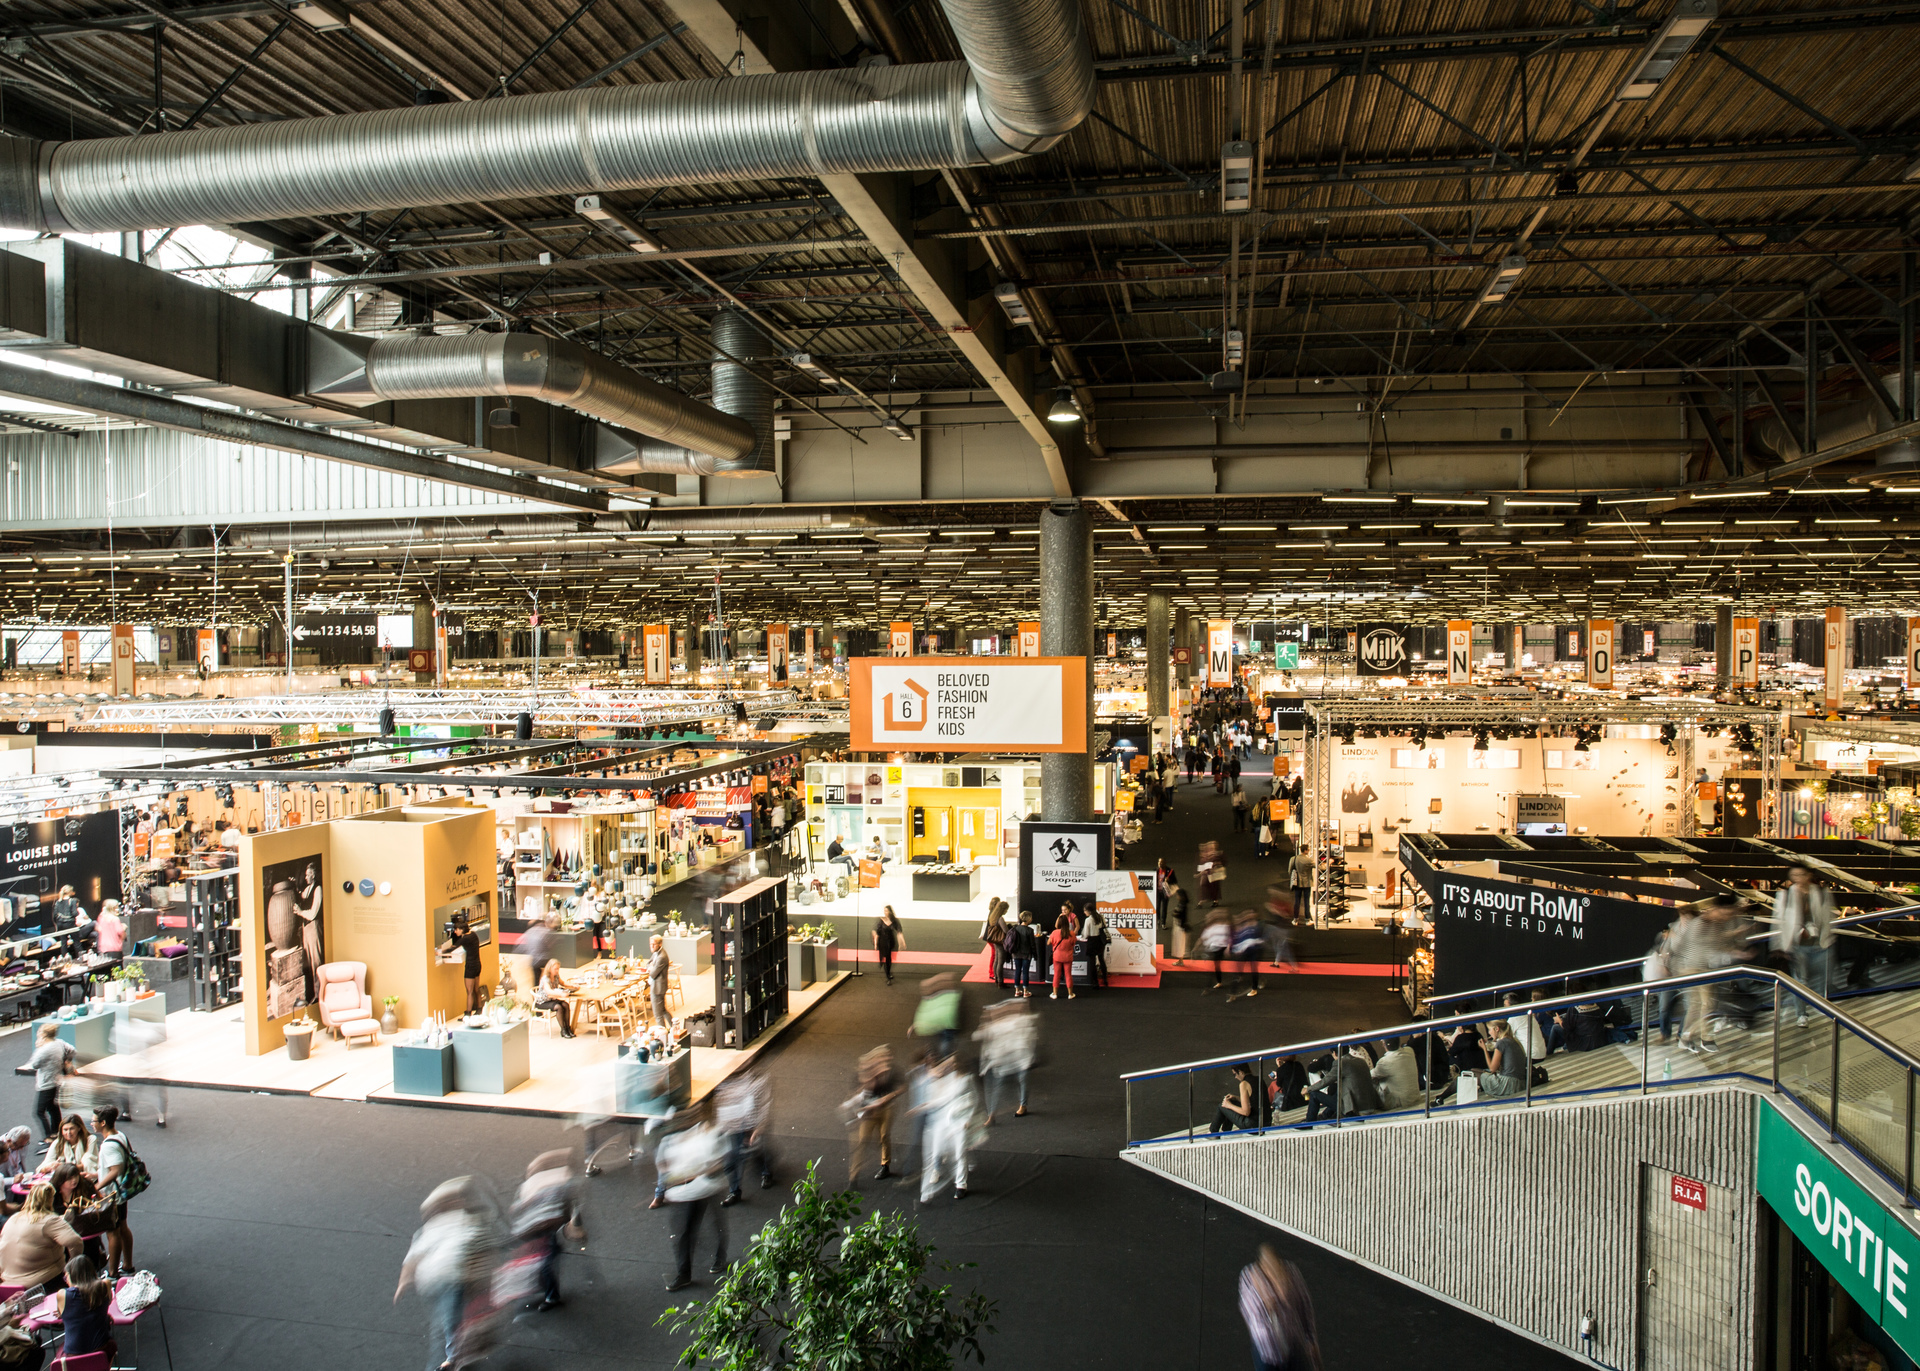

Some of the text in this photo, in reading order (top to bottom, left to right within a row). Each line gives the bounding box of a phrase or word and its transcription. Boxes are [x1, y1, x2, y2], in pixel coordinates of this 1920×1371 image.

[321, 626, 326, 636] 1
[327, 626, 334, 636] 2
[335, 626, 342, 636] 3
[343, 626, 350, 636] 4
[351, 626, 363, 636] 5A
[364, 626, 376, 636] 5B
[1212, 651, 1228, 673] M
[1453, 651, 1467, 674] N
[1595, 650, 1608, 674] O
[1740, 650, 1752, 673] P
[938, 674, 990, 687] BELOVED
[938, 690, 988, 703] FASHION
[902, 700, 912, 719] 6
[938, 706, 975, 720] FRESH
[938, 722, 965, 736] KIDS
[826, 786, 844, 800] Fill
[1519, 802, 1564, 811] LINDDNA
[6, 840, 78, 864] LOUISE ROE
[18, 857, 68, 872] COPENHAGEN
[1060, 870, 1088, 878] BATTERIE
[1442, 884, 1470, 904] IT'S
[1473, 889, 1526, 913] ABOUT
[1442, 904, 1584, 940] AMSTERDAM
[1674, 1184, 1702, 1204] R.I.A
[1794, 1163, 1908, 1318] SORTIE
